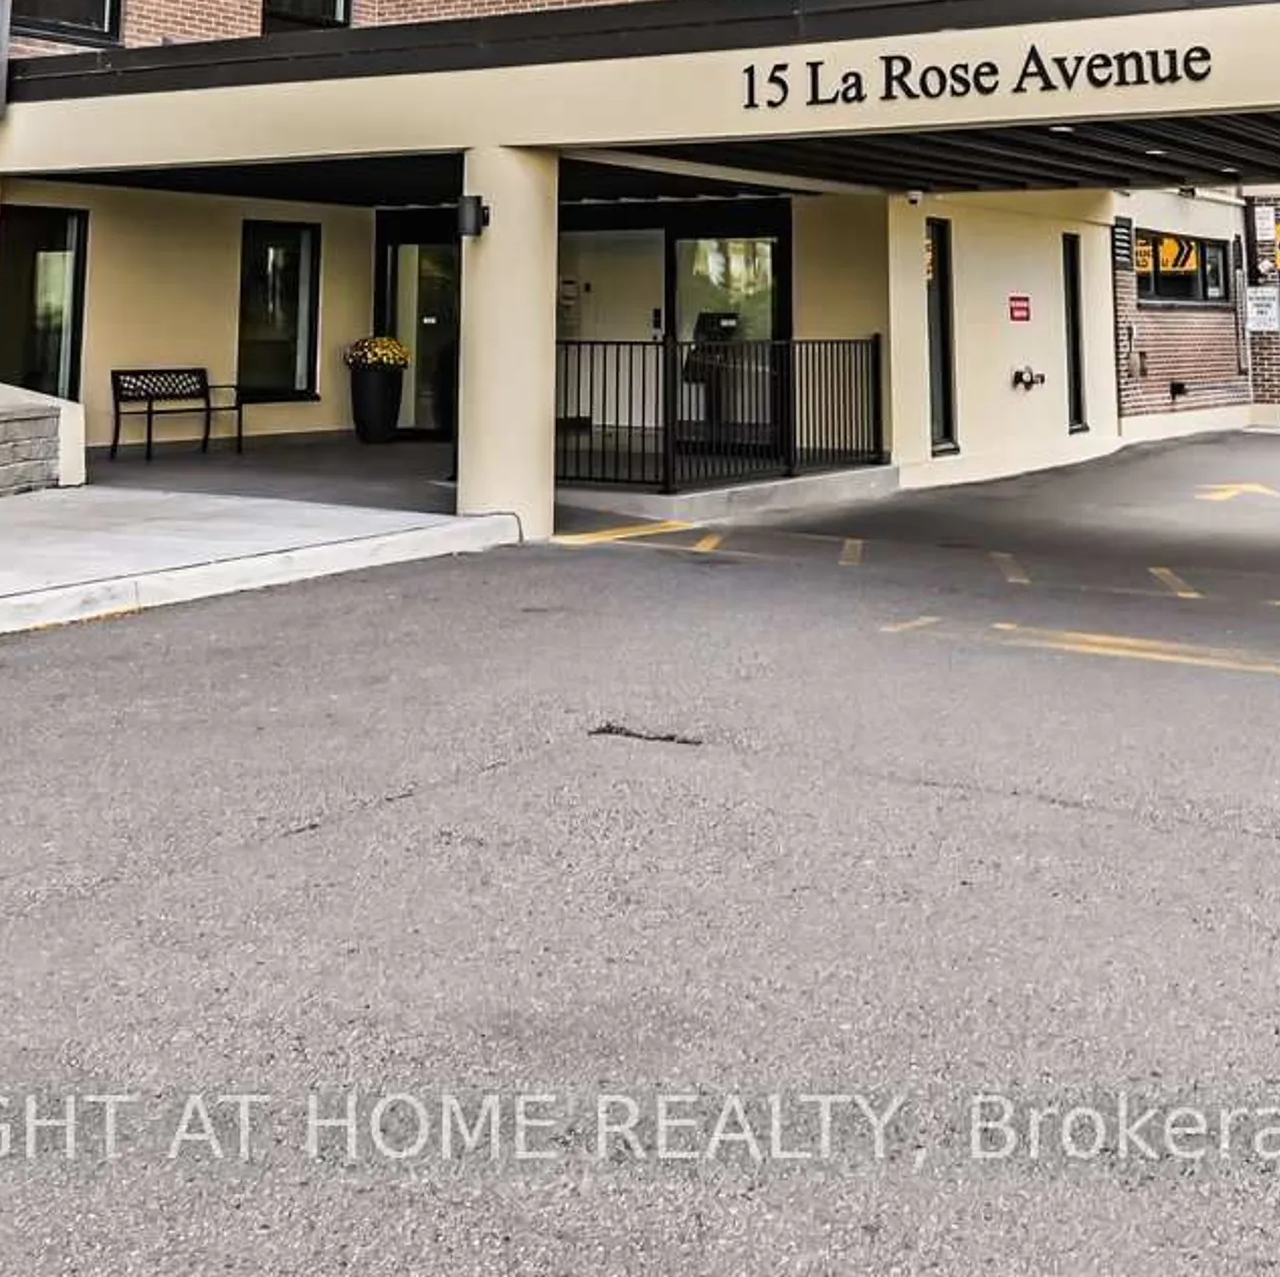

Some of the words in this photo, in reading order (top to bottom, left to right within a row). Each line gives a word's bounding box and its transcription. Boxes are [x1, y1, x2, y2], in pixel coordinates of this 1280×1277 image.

[742, 64, 789, 108] 15
[806, 61, 866, 106] La
[880, 55, 1000, 100] Rose
[1012, 44, 1212, 94] Avenue
